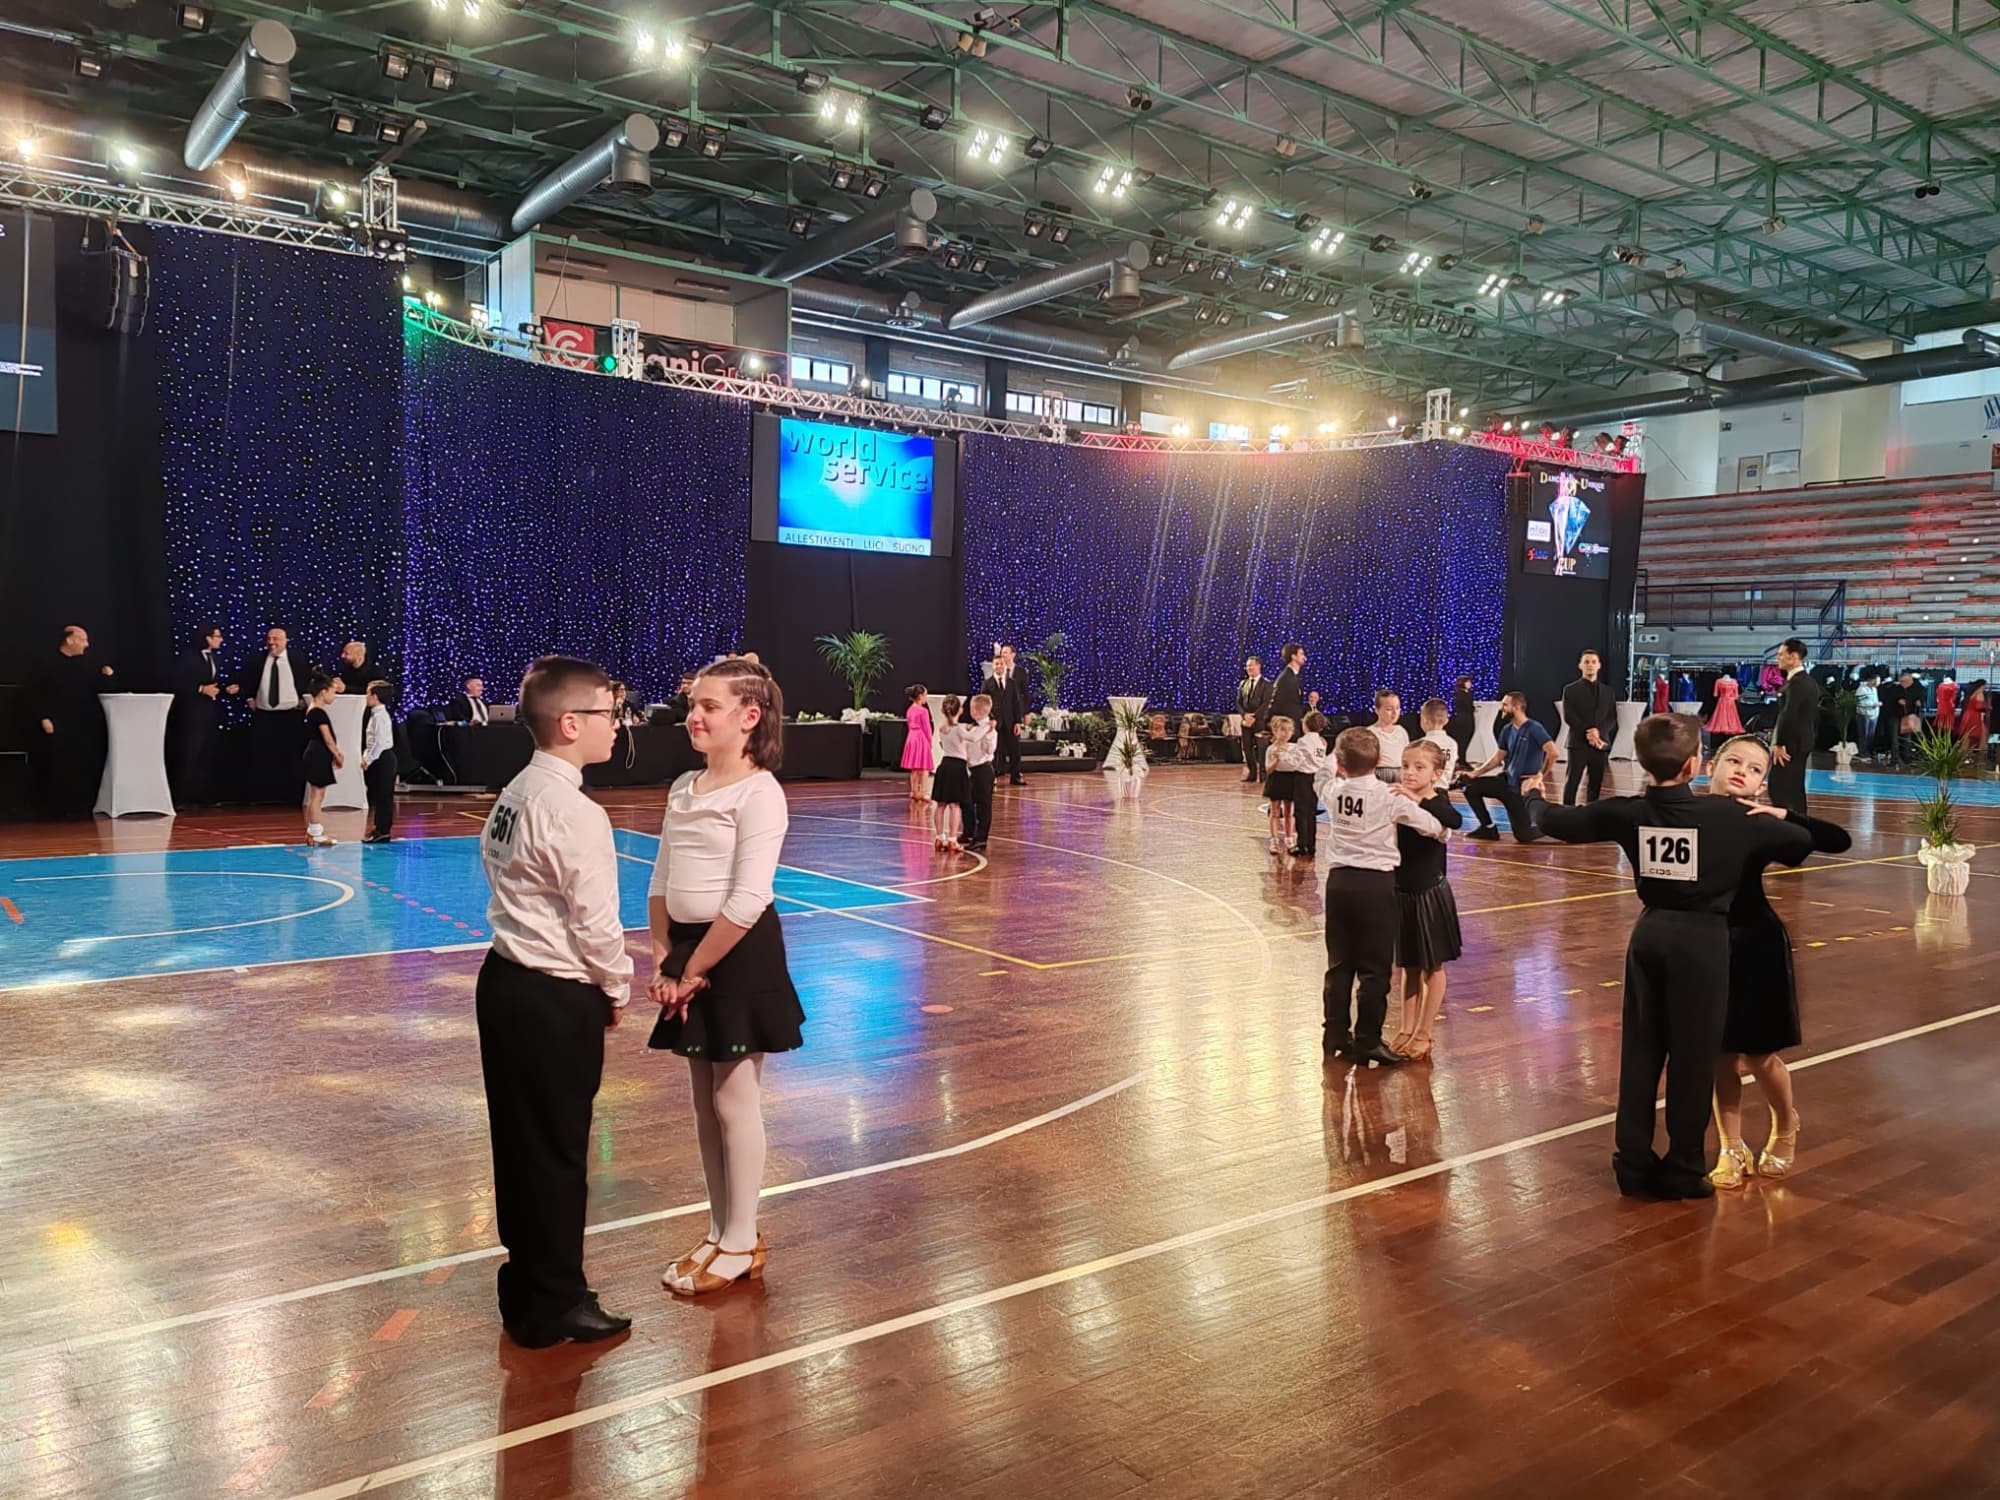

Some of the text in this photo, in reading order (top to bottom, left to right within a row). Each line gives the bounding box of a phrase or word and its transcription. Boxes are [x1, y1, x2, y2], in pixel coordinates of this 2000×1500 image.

[788, 430, 877, 462] world
[823, 460, 928, 492] service
[785, 532, 925, 553] ALLESTIMENTI LUCI SUONO
[1337, 794, 1363, 818] 194
[491, 804, 518, 845] 561
[1646, 835, 1690, 864] 126
